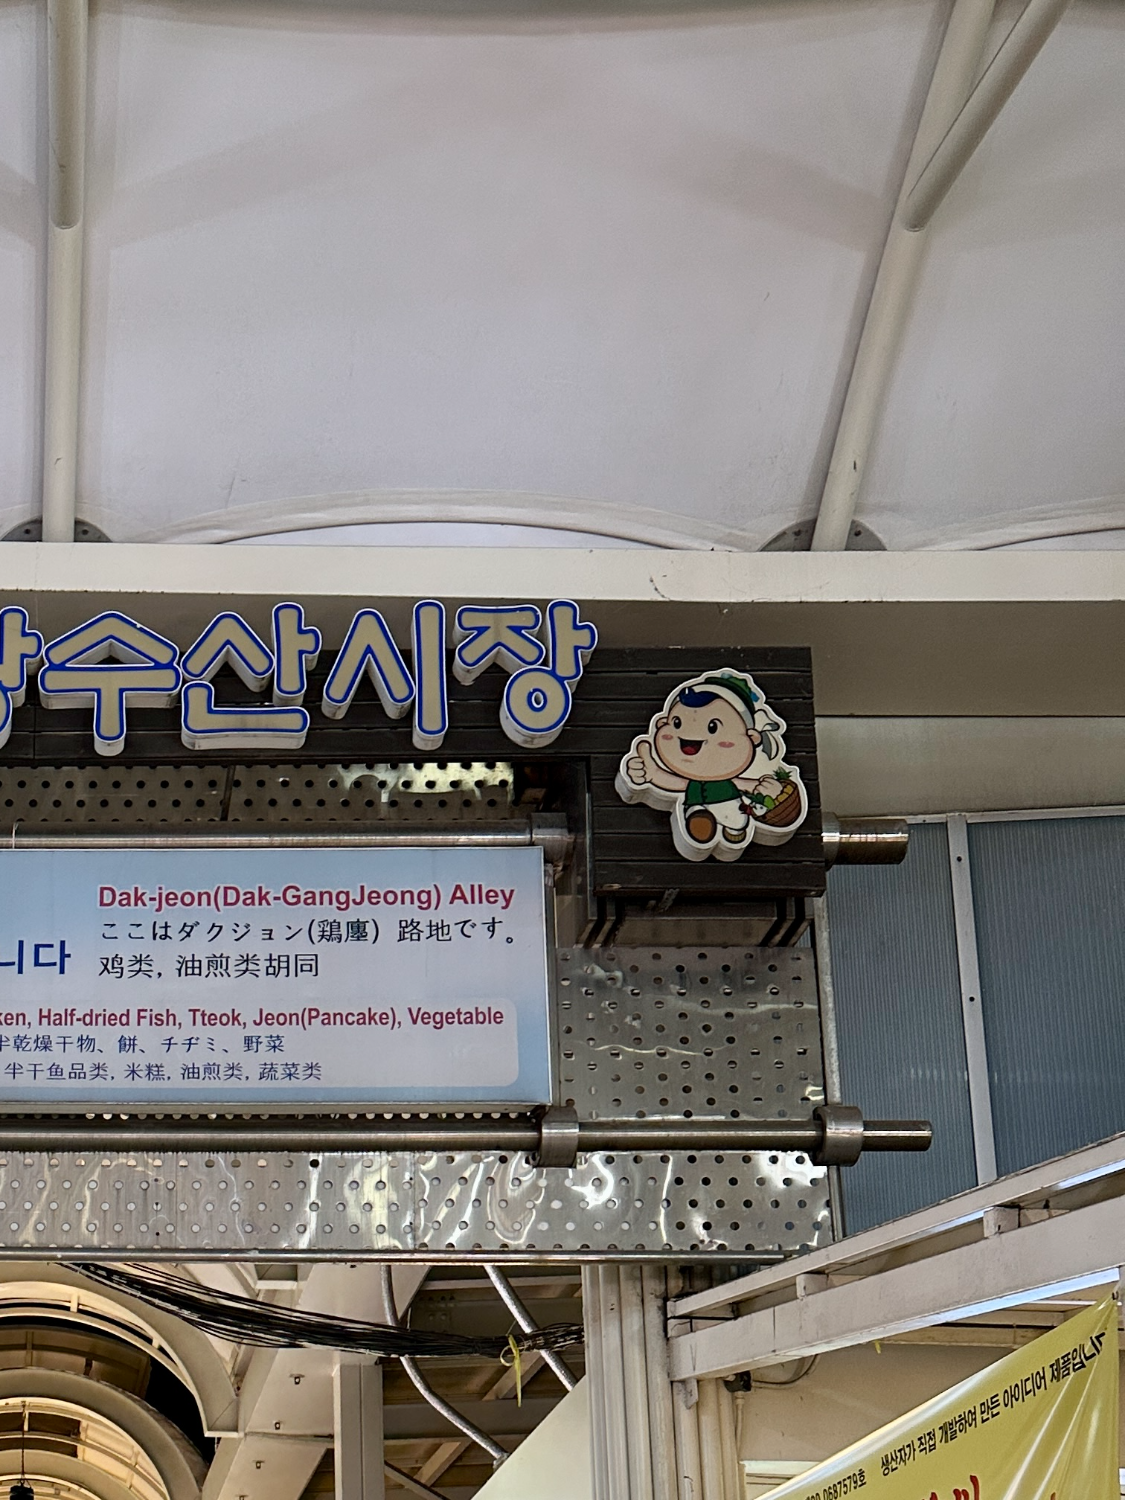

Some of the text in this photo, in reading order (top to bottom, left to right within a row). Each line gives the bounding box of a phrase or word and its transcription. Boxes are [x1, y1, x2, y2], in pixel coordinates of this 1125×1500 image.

[98, 884, 515, 912] Dak-jeon(Dak-GangJeong) Alley
[38, 1006, 130, 1028] Half-dried
[137, 1007, 183, 1030] Fish,
[188, 1007, 247, 1030] Tteok,
[253, 1006, 403, 1031] Jeon(Pancake),
[407, 1005, 504, 1031] Vegetable
[880, 1440, 916, 1477] 생산자가
[917, 1429, 937, 1455] 직접
[939, 1405, 978, 1444] 개발하여
[980, 1393, 1001, 1424] 만든
[1003, 1366, 1048, 1409] 아이디어
